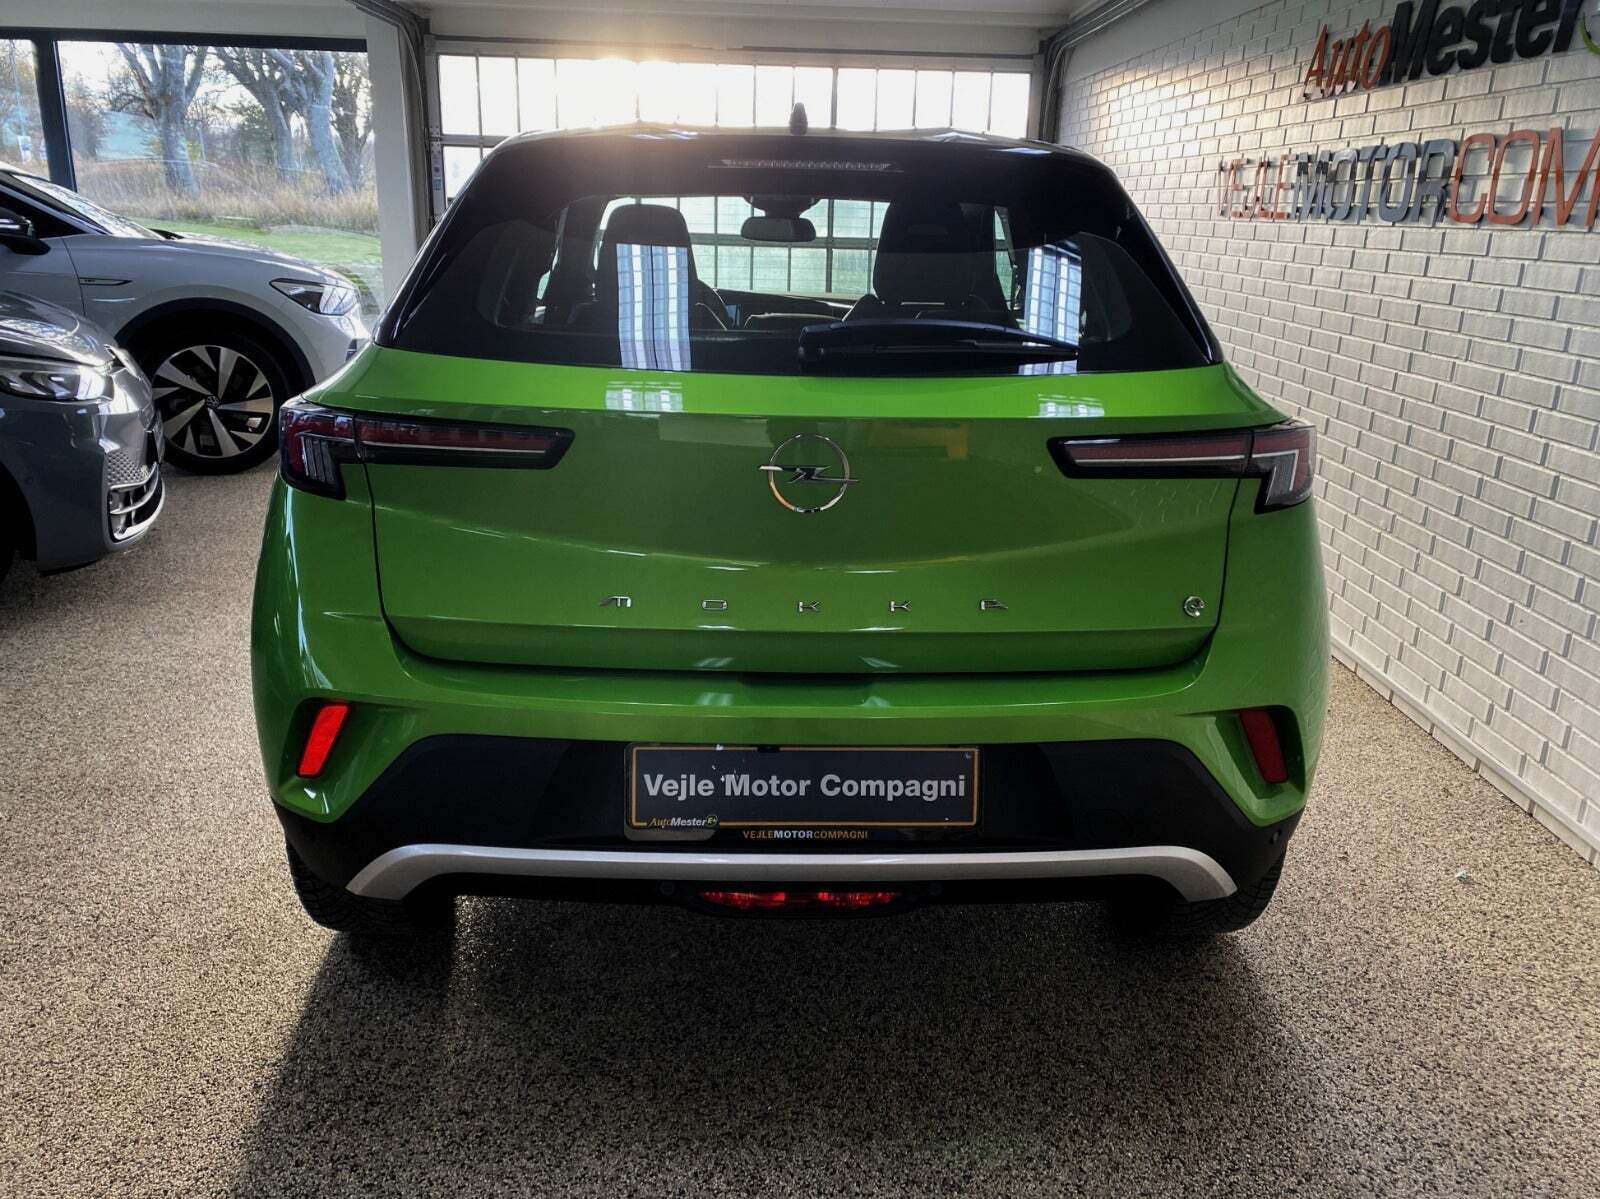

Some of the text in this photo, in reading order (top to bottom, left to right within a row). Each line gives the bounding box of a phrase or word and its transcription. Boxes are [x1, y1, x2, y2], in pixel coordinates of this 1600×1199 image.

[1303, 0, 1584, 99] AutoMester
[643, 774, 966, 801] Vejle Motor Compagni
